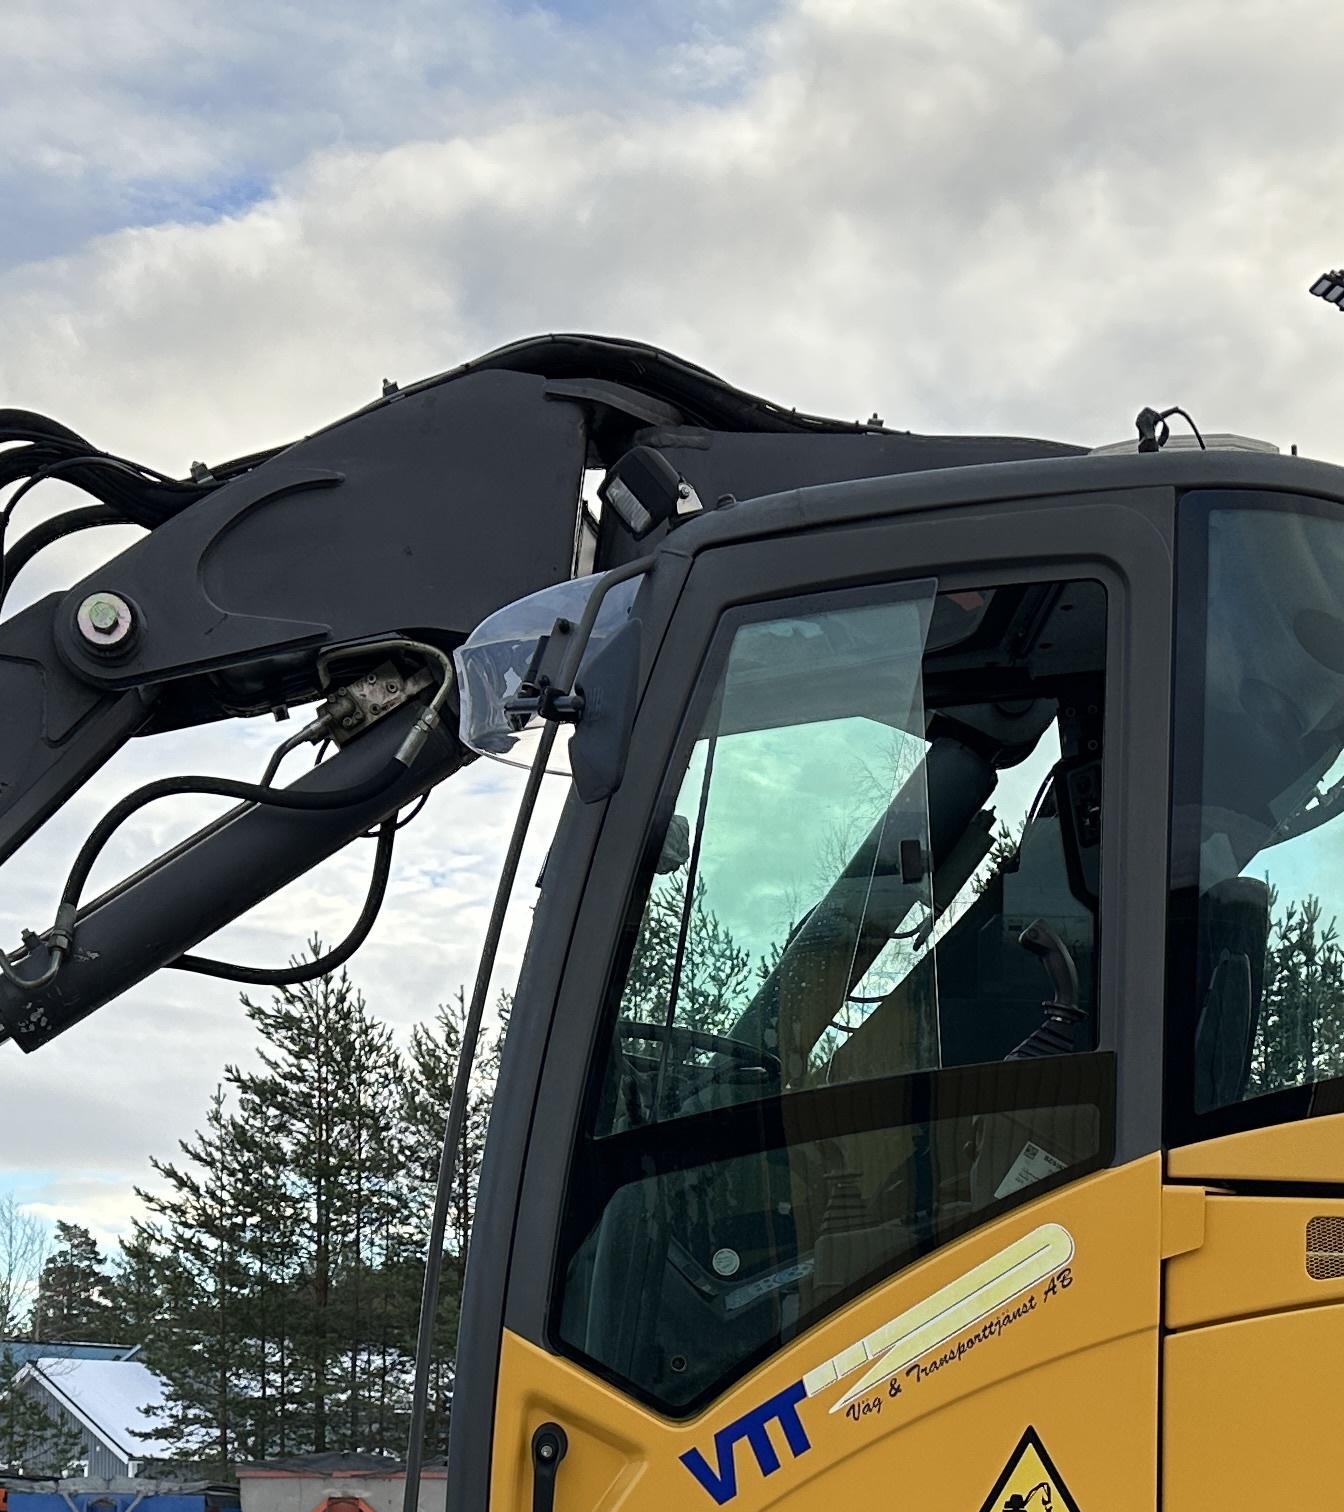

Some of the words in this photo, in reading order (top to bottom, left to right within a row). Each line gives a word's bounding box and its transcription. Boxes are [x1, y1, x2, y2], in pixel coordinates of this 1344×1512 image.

[845, 1397, 883, 1421] Väg
[888, 1377, 902, 1397] &
[905, 1295, 1037, 1382] Transporttjänst
[1043, 1267, 1073, 1302] AB
[678, 1378, 812, 1505] VTT
